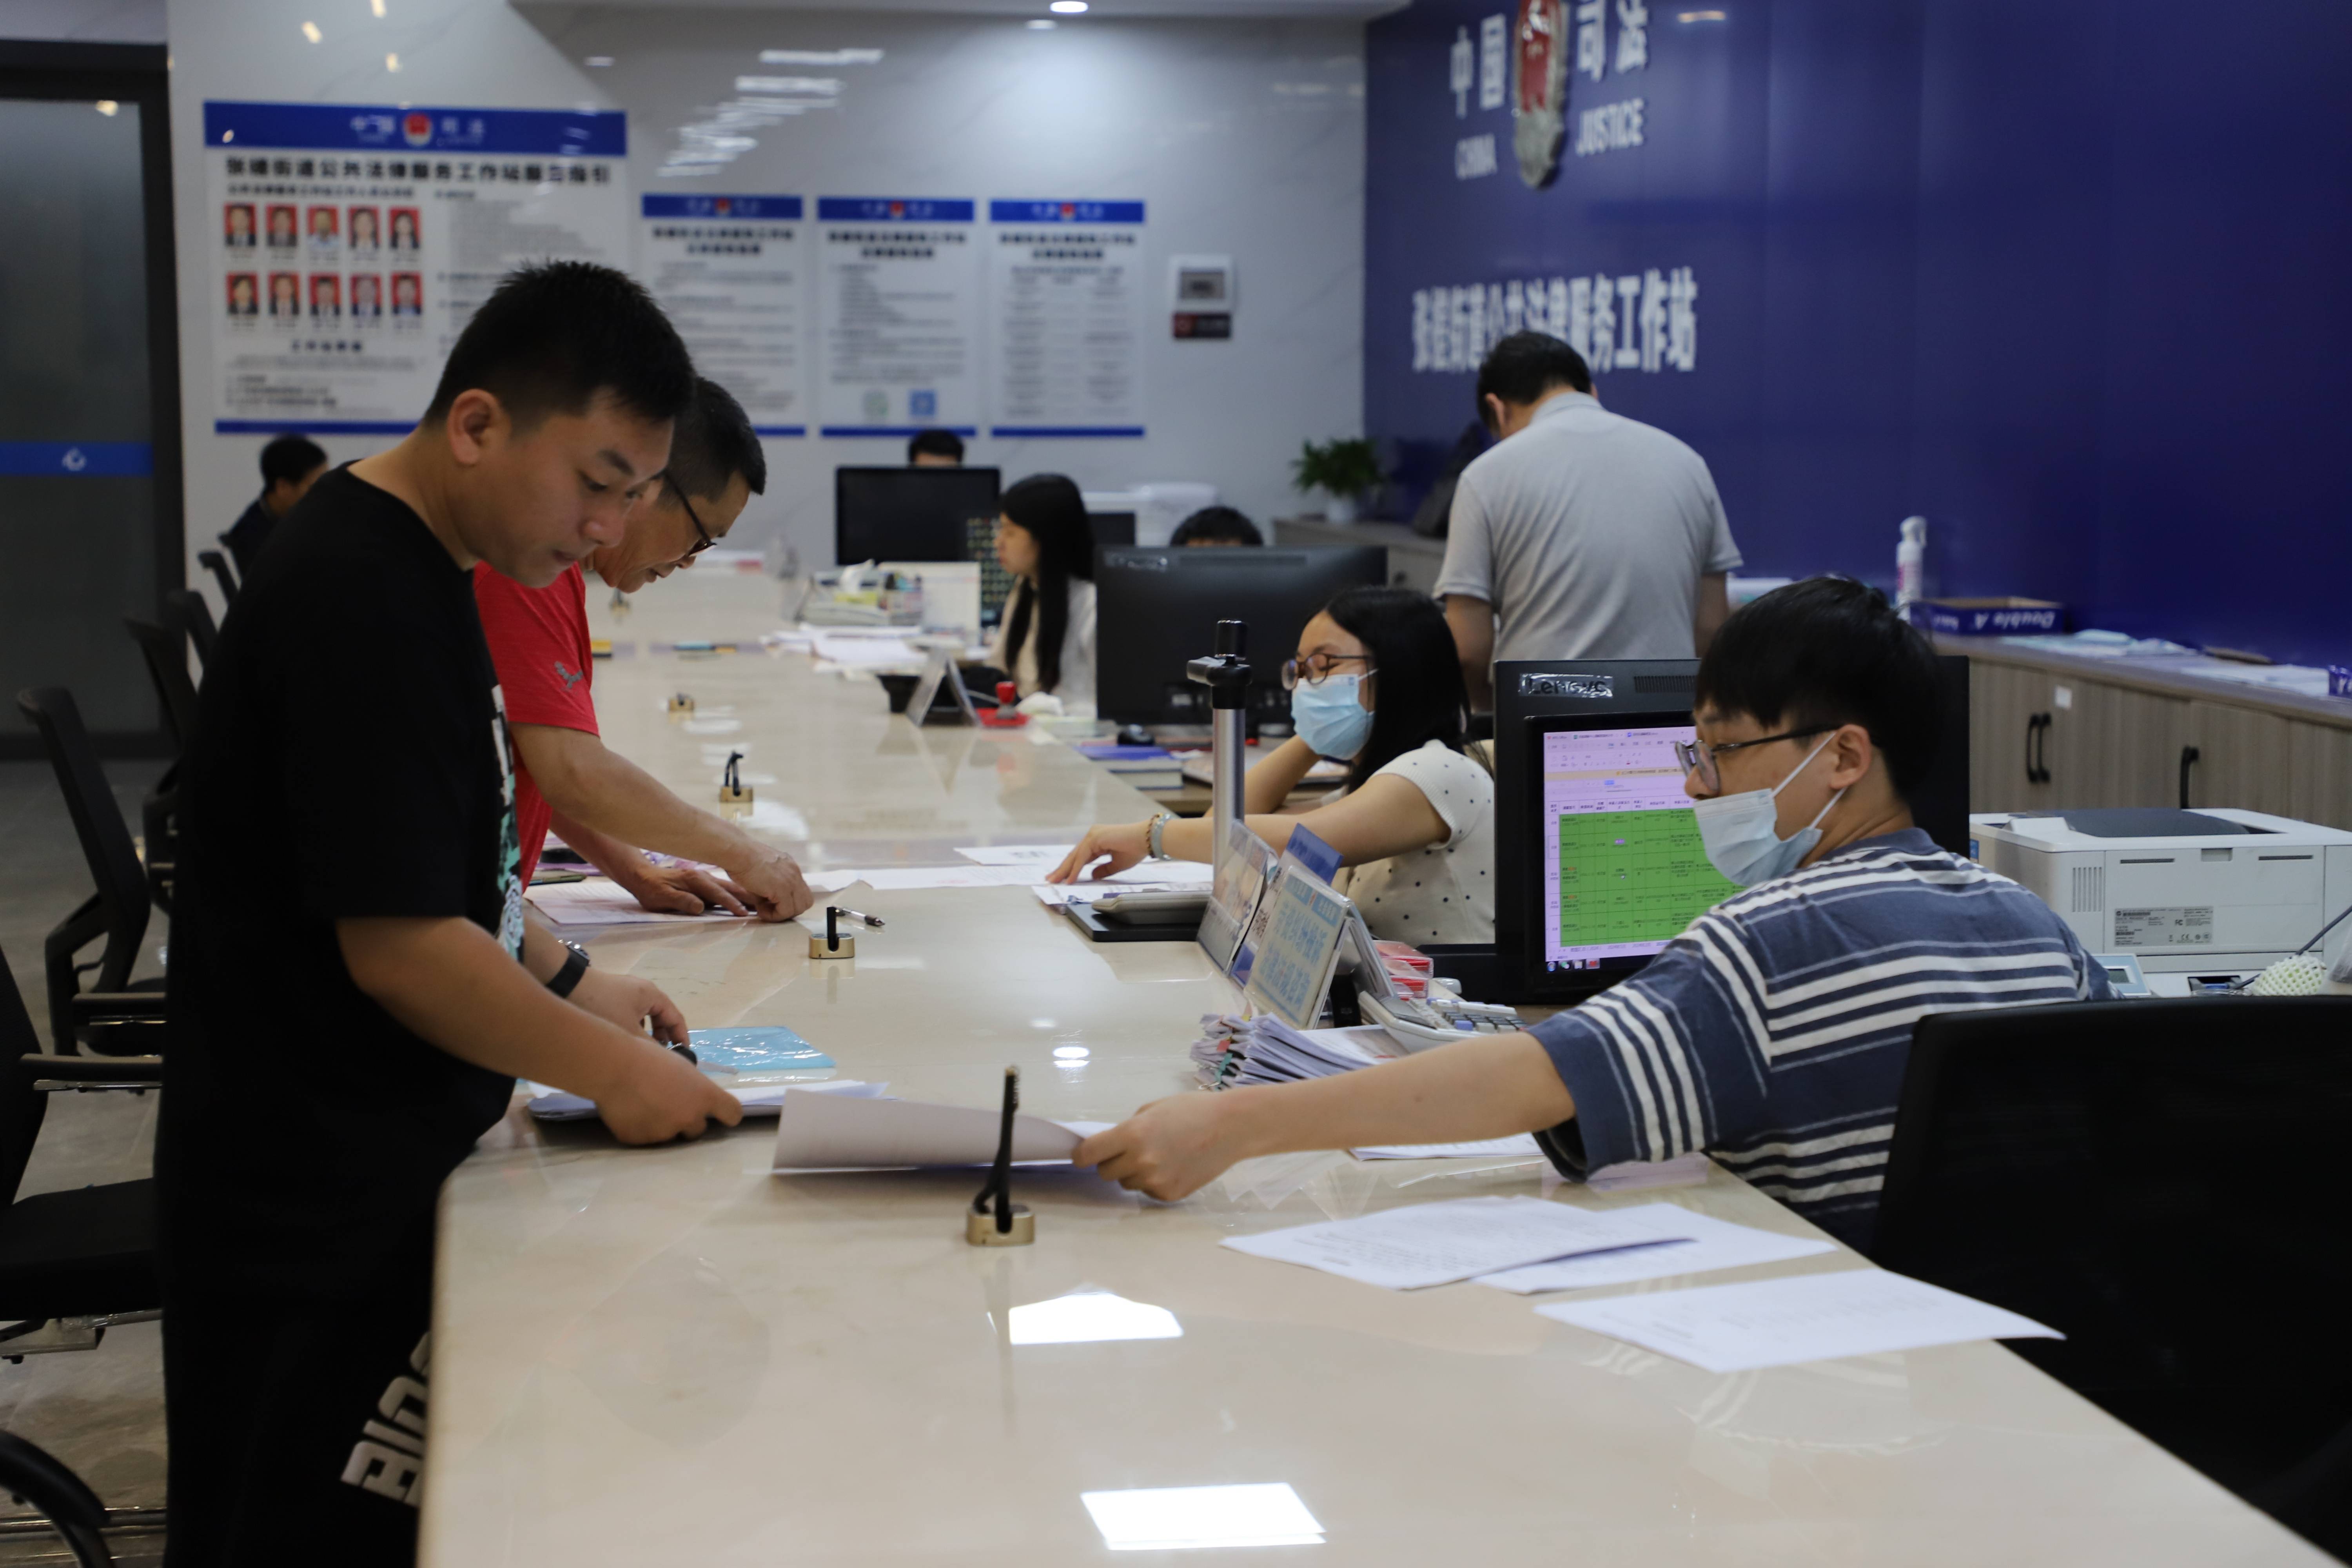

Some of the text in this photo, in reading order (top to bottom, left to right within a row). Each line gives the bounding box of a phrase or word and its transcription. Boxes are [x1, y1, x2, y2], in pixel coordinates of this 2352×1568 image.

[1576, 98, 1644, 156] JUSTICE
[1975, 612, 1990, 630] A
[1994, 611, 2055, 629] Double
